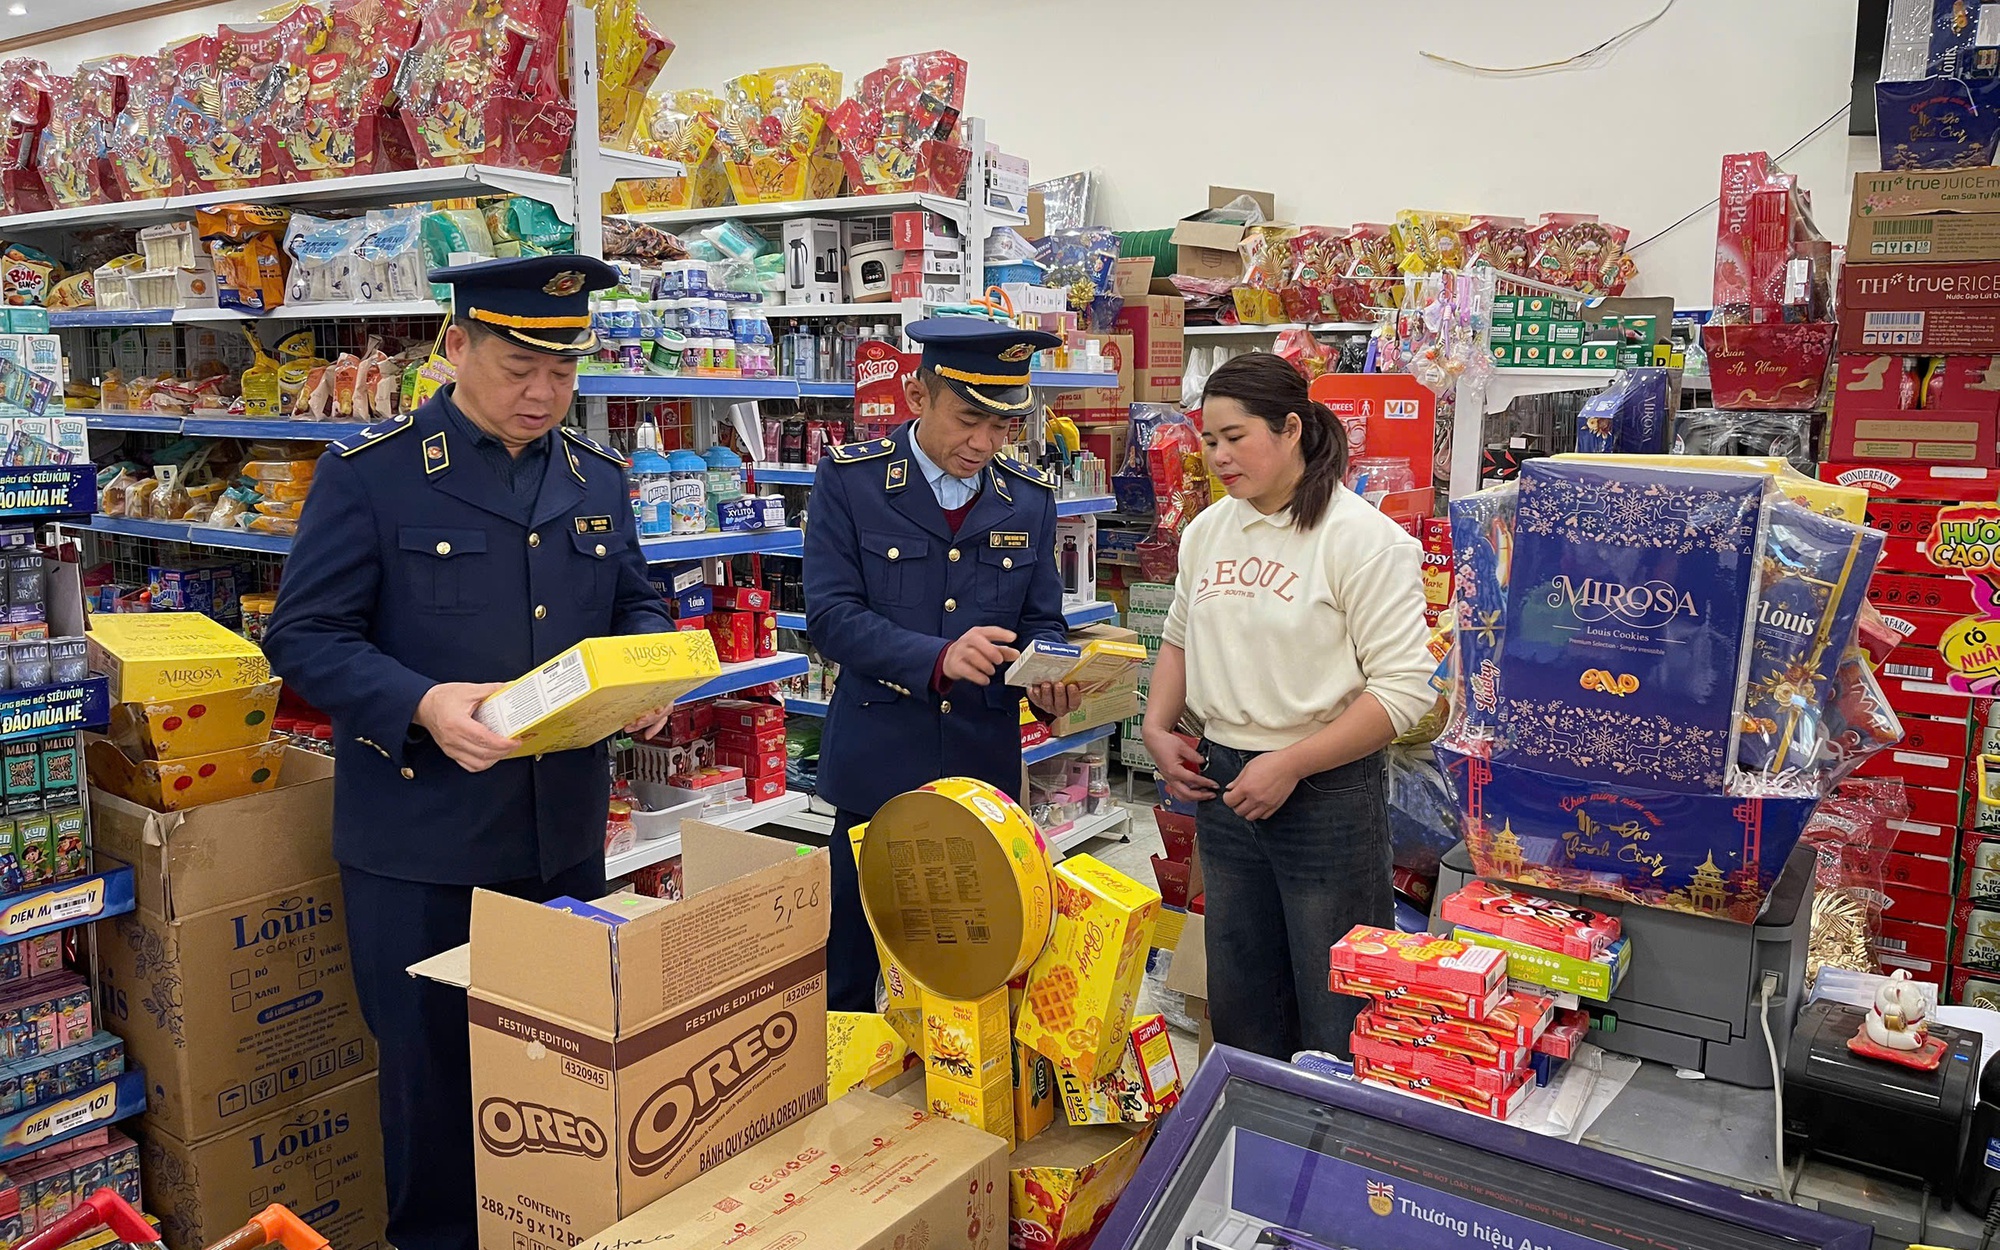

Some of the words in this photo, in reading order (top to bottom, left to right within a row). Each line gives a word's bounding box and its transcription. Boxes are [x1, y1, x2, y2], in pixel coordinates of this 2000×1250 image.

[1906, 177, 1940, 190] true
[1942, 176, 1985, 190] JUICE
[1941, 193, 1960, 201] Cam
[1857, 278, 1889, 294] TH
[1907, 275, 1954, 292] true
[1957, 275, 2000, 291] RICE
[1755, 359, 1788, 375] Khang
[1839, 468, 1897, 487] WONDERFARM
[16, 484, 50, 508] MÙA
[50, 484, 69, 506] HÈ
[728, 507, 755, 517] XYLITOL
[12, 556, 42, 568] MALTO
[1933, 544, 1990, 568] CAO
[1547, 576, 1699, 629] MIROSA
[1758, 600, 1816, 636] Louis
[1587, 625, 1613, 638] Louis
[1614, 628, 1650, 643] Cookies
[14, 646, 47, 660] MALTO
[53, 643, 86, 657] MALTO
[624, 642, 677, 667] MIROSA
[158, 666, 223, 688] MIROSA
[1475, 658, 1500, 714] Lucky
[47, 689, 67, 703] SIÊU
[67, 687, 84, 699] KUN
[2, 706, 33, 734] ĐẢO
[32, 704, 65, 728] MÙA
[65, 700, 83, 722] HÈ
[6, 742, 37, 756] MALTO
[45, 737, 74, 750] MALTO
[11, 907, 35, 925] DIỆN
[231, 896, 333, 950] Louis
[254, 932, 316, 958] COOKIES
[255, 985, 281, 1001] XANH
[785, 979, 821, 1004] 4320945
[685, 1001, 730, 1032] FESTIVE
[732, 981, 775, 1011] EDITION
[953, 1011, 974, 1022] CHOC
[497, 1016, 538, 1041] FESTIVE
[538, 1029, 580, 1053] EDITION
[564, 1061, 605, 1086] 4320945
[1036, 1060, 1046, 1099] Cozy
[630, 1012, 797, 1175] OREO
[958, 1096, 979, 1108] CHOC
[1077, 1096, 1088, 1122] Café
[26, 1116, 50, 1136] DIỆN
[480, 1098, 607, 1159] OREO
[700, 1141, 725, 1173] BÁNH
[725, 1130, 744, 1158] QUY
[776, 1101, 798, 1126] OREO
[798, 1095, 807, 1118] VỊ
[806, 1082, 825, 1110] VANI
[249, 1109, 350, 1169] Louis
[272, 1143, 333, 1175] COOKIES
[664, 1153, 687, 1180] Chocolate
[517, 1194, 571, 1226] CONTENTS
[1450, 1177, 1470, 1190] LOAD
[1470, 1185, 1484, 1195] THE
[1485, 1189, 1524, 1208] PRODUCTS
[1525, 1202, 1550, 1215] ABOVE
[1551, 1209, 1568, 1220] THIS
[481, 1195, 524, 1226] 288,75
[526, 1216, 536, 1233] g
[537, 1221, 546, 1235] x
[548, 1222, 565, 1242] 12
[1398, 1196, 1468, 1239] Thương
[1473, 1222, 1514, 1250] hiệu
